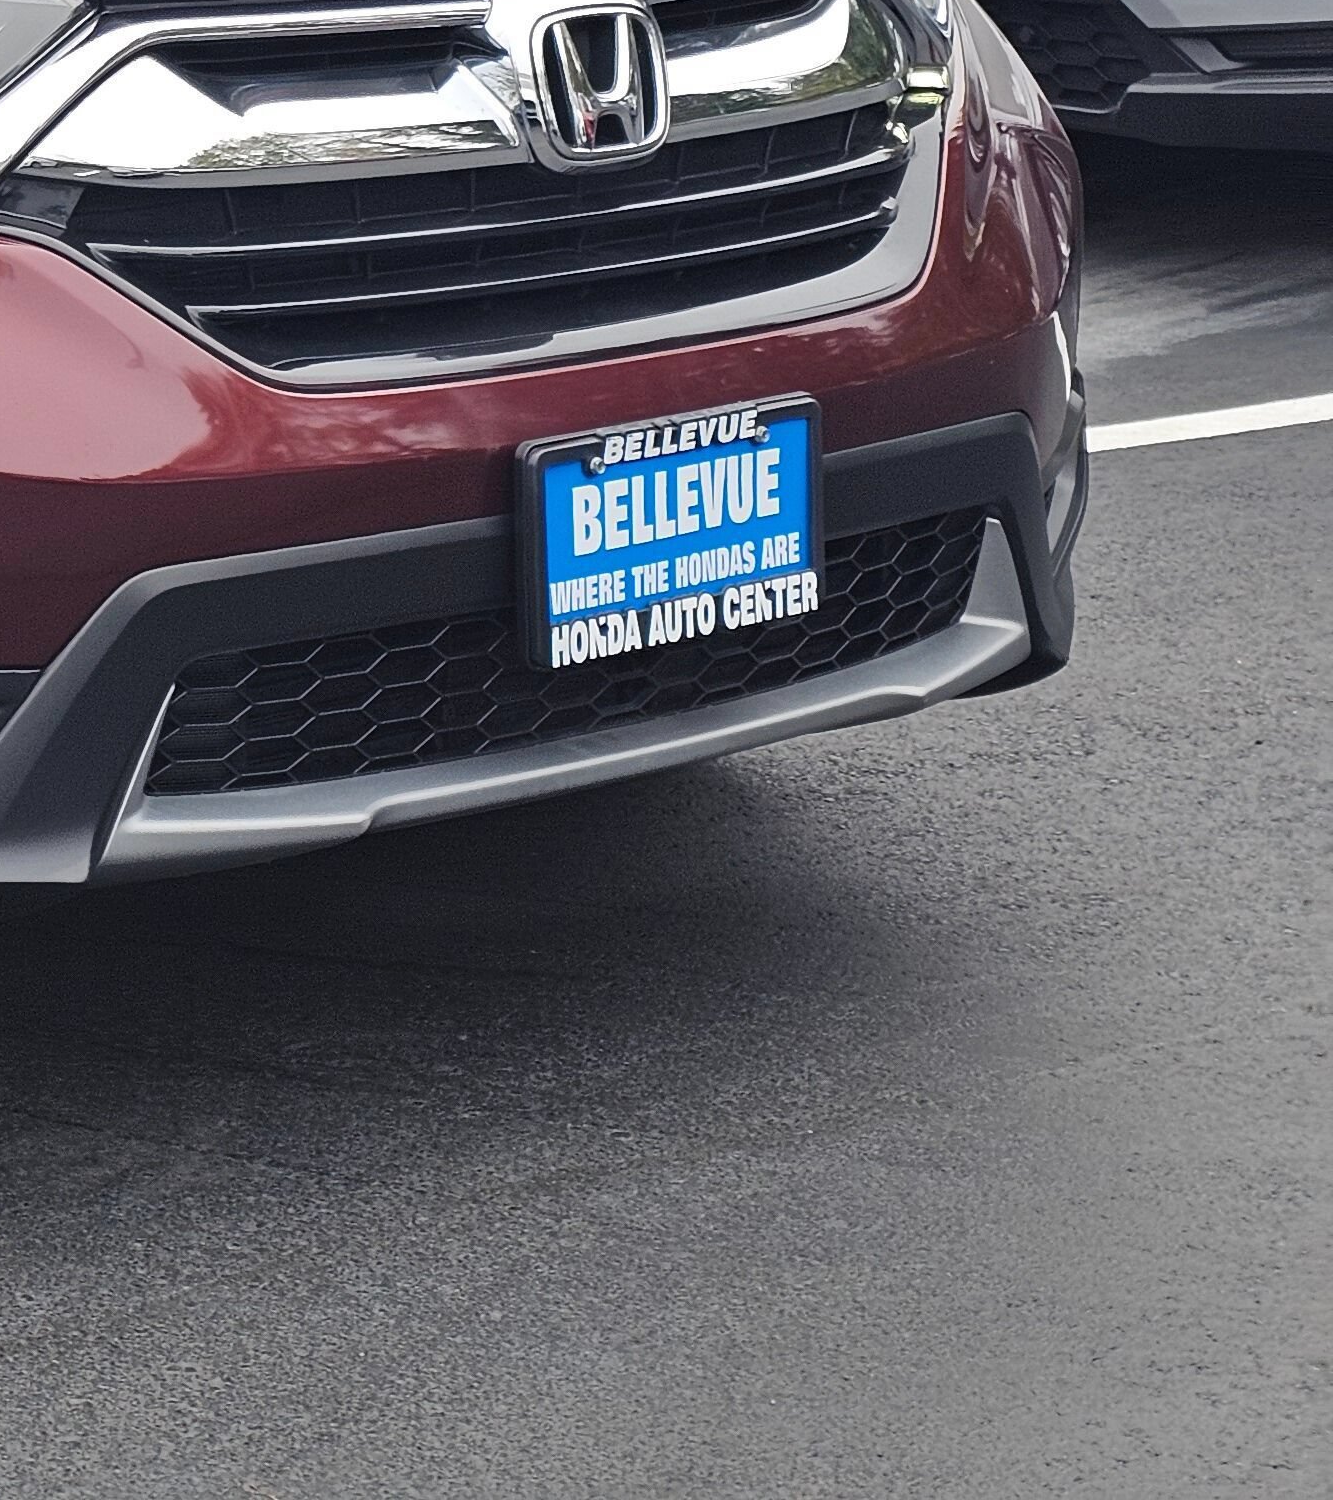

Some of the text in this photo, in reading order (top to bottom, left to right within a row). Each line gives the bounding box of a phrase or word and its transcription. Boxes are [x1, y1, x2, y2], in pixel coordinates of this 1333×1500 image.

[602, 409, 759, 466] BELLEVUE
[571, 447, 781, 557] BELLEVUE
[549, 531, 801, 616] WHERE THE HONDAS ARE
[550, 570, 820, 669] HONDA AUTO CENTER
